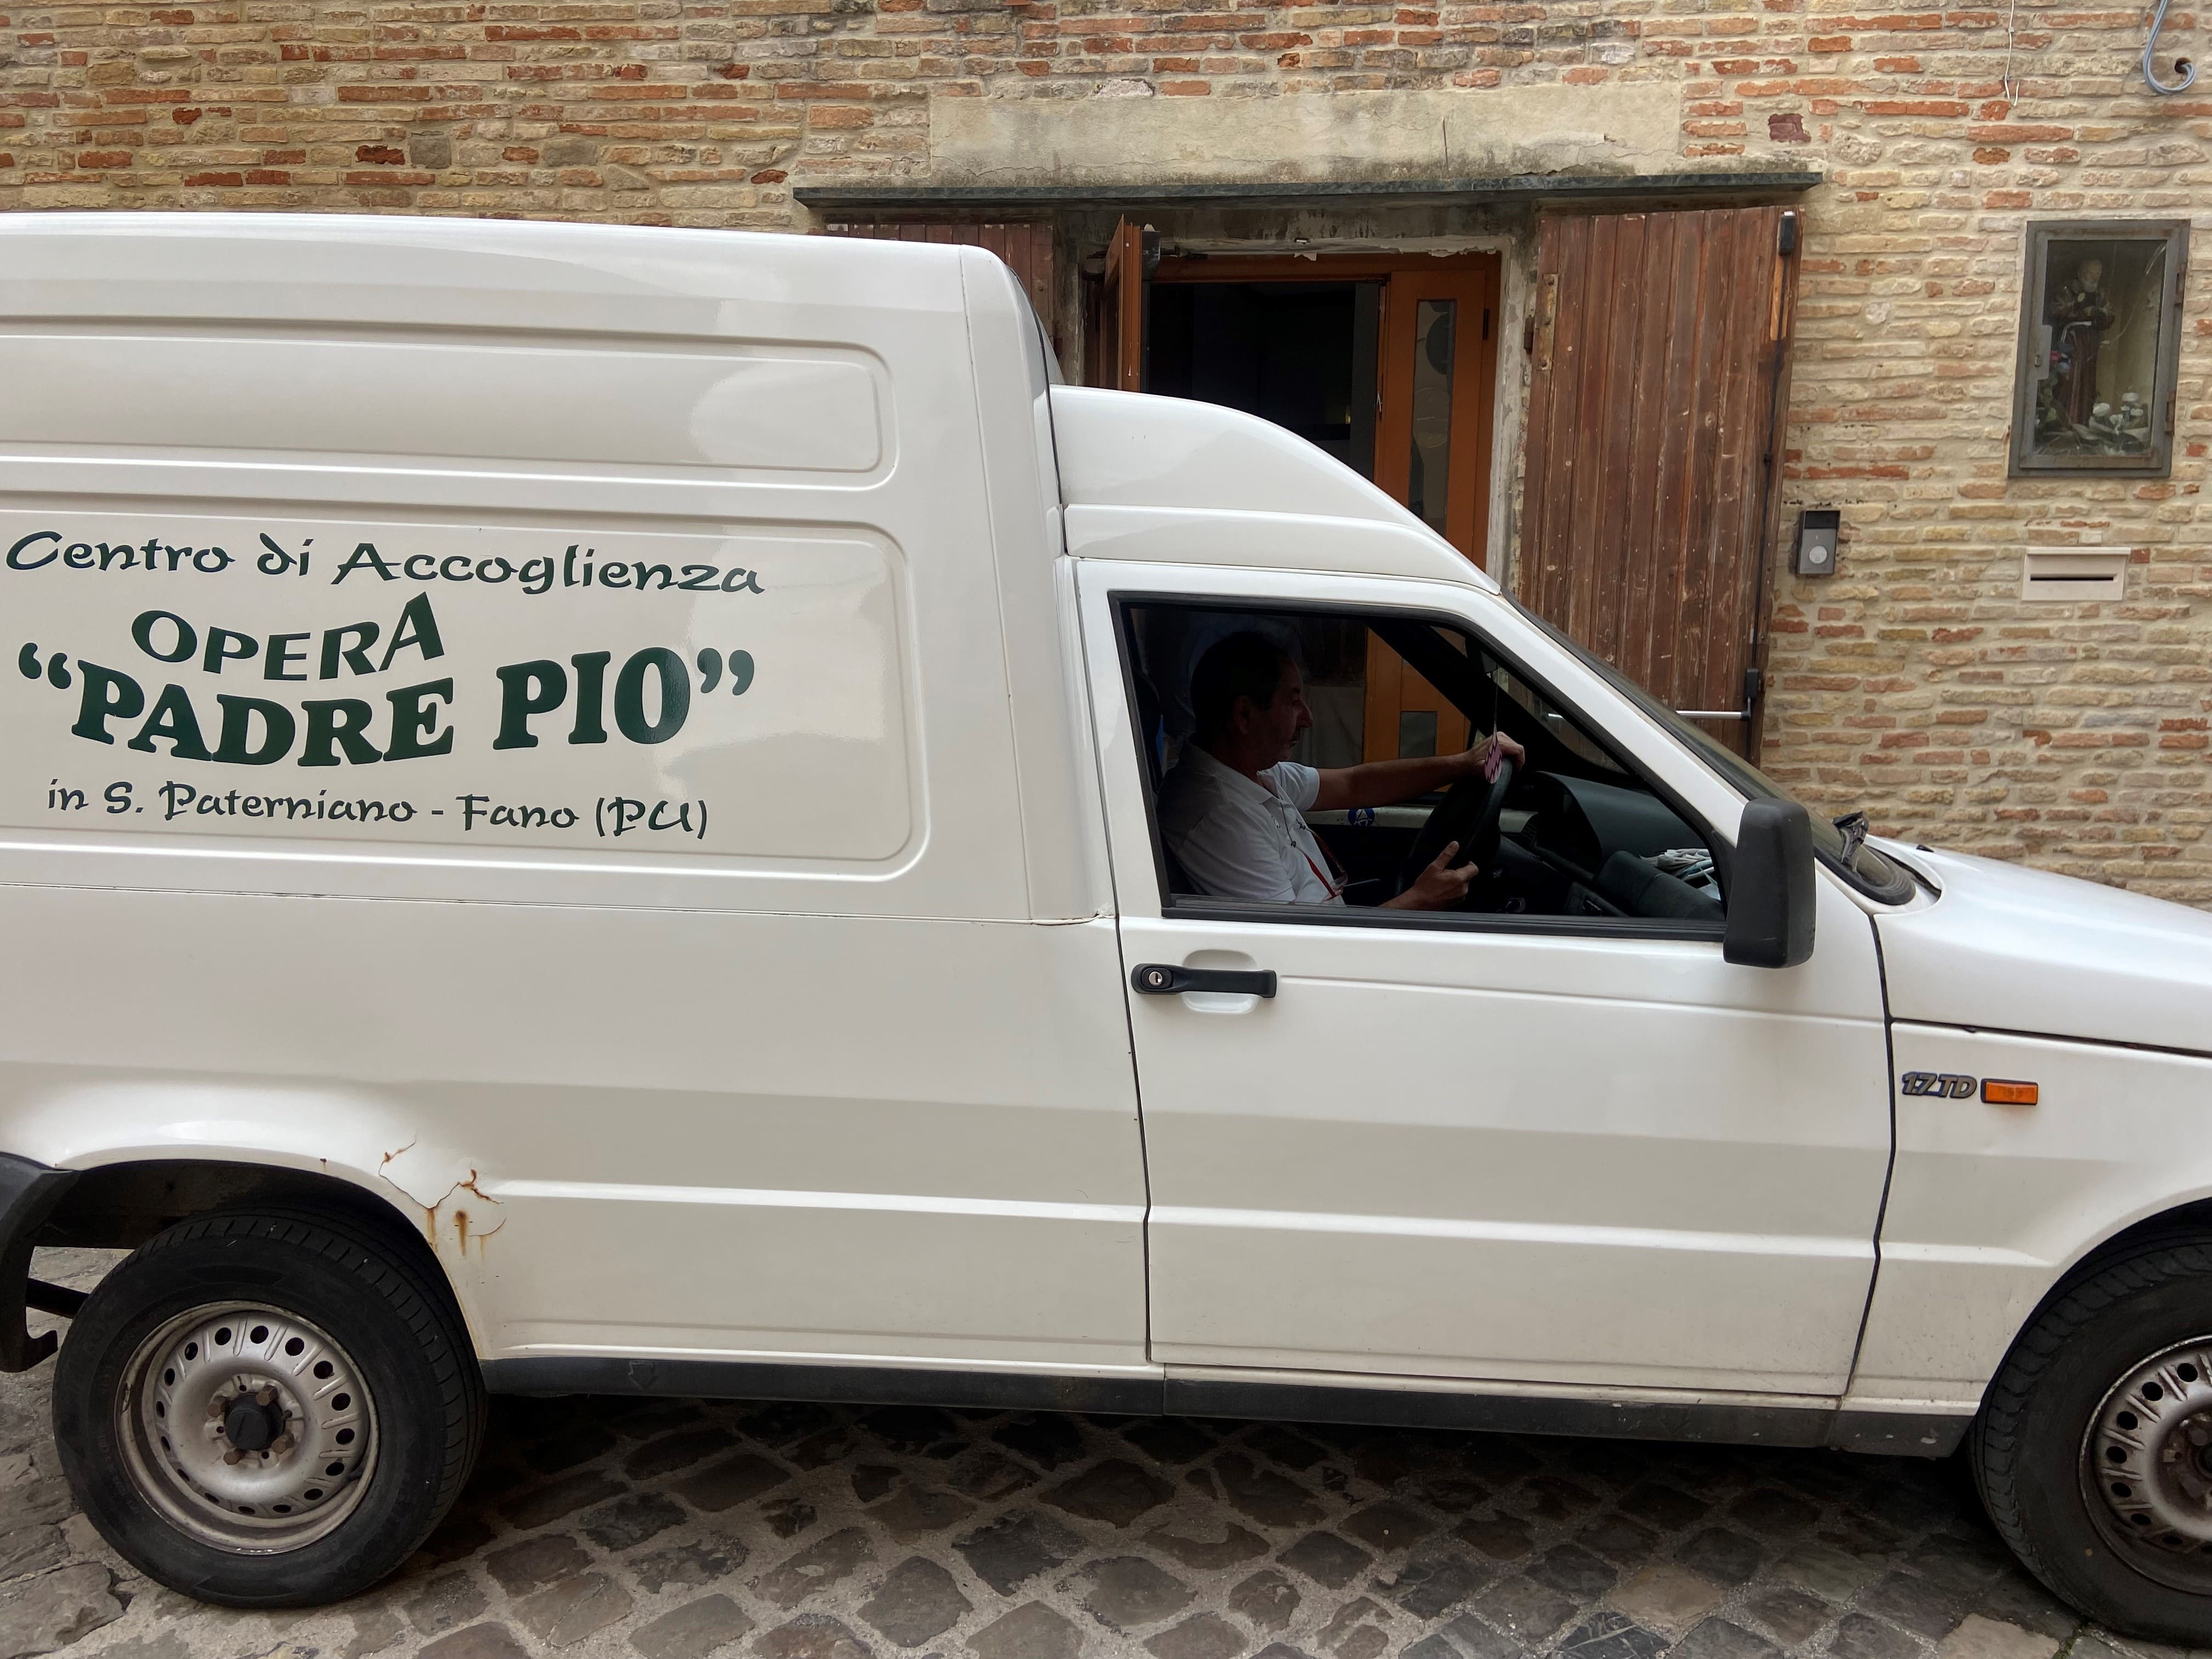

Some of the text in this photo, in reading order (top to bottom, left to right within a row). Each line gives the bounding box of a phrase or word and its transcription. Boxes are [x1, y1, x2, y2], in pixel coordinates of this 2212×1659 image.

[7, 531, 765, 594] Centro di Accoglienza
[132, 591, 444, 681] OPERA
[19, 642, 754, 766] “PADRE PIO”
[49, 779, 89, 810] in
[104, 782, 144, 814] S.
[159, 781, 418, 822] Paterniano
[455, 794, 580, 831] Fano
[596, 797, 707, 839] (PU)
